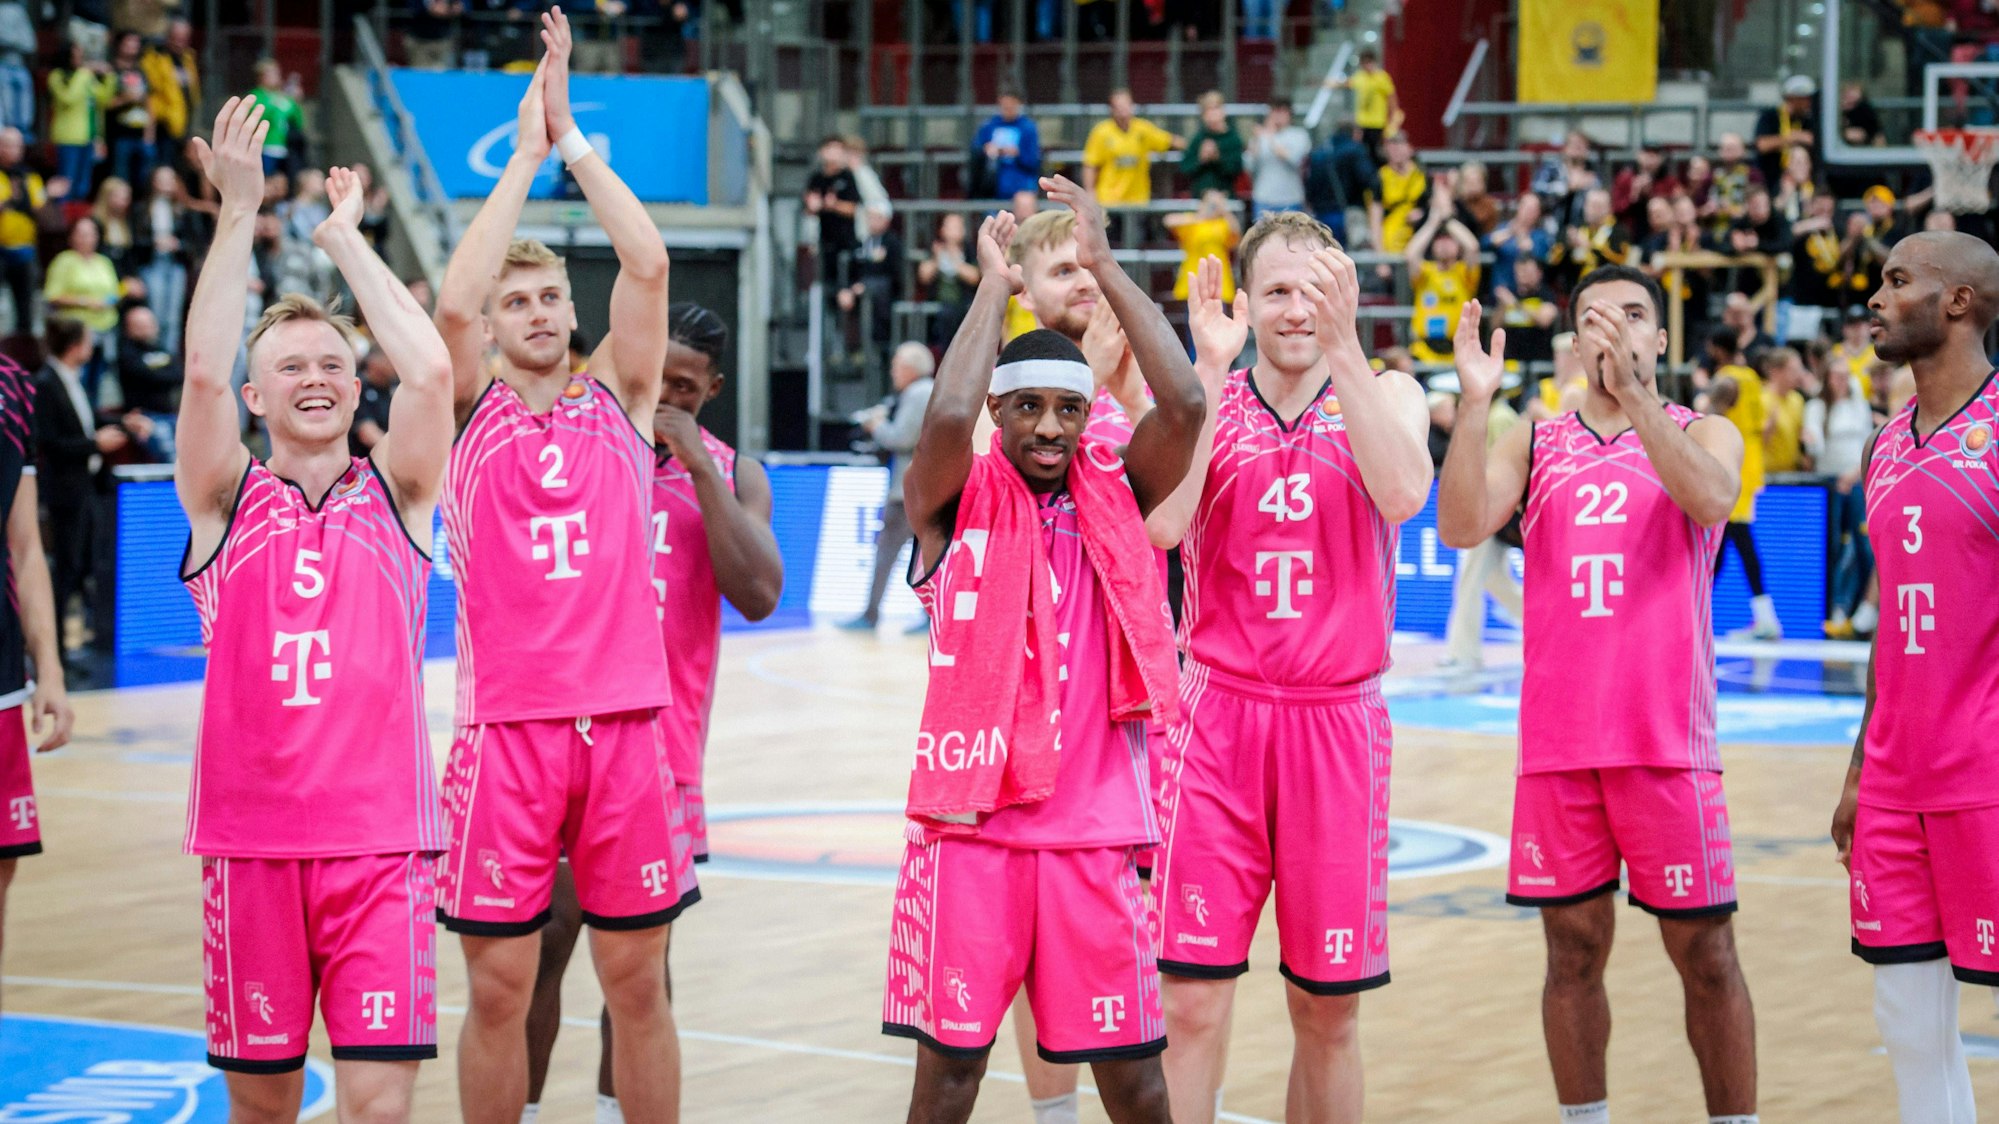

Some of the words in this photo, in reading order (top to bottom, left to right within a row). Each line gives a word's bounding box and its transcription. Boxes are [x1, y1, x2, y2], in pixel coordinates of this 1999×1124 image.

[539, 444, 568, 489] 2
[1258, 473, 1314, 522] 43
[1575, 481, 1628, 526] 22
[530, 510, 590, 580] T
[1902, 506, 1923, 554] 3
[293, 549, 325, 599] 5
[1255, 550, 1314, 619] T
[1571, 553, 1624, 618] T
[1898, 583, 1935, 655] T
[271, 629, 332, 707] T
[10, 795, 36, 830] T
[640, 860, 669, 897] T
[1664, 864, 1694, 897] T
[1325, 928, 1354, 964] T
[1976, 918, 1995, 956] T
[361, 991, 396, 1030] T
[1092, 995, 1126, 1033] T
